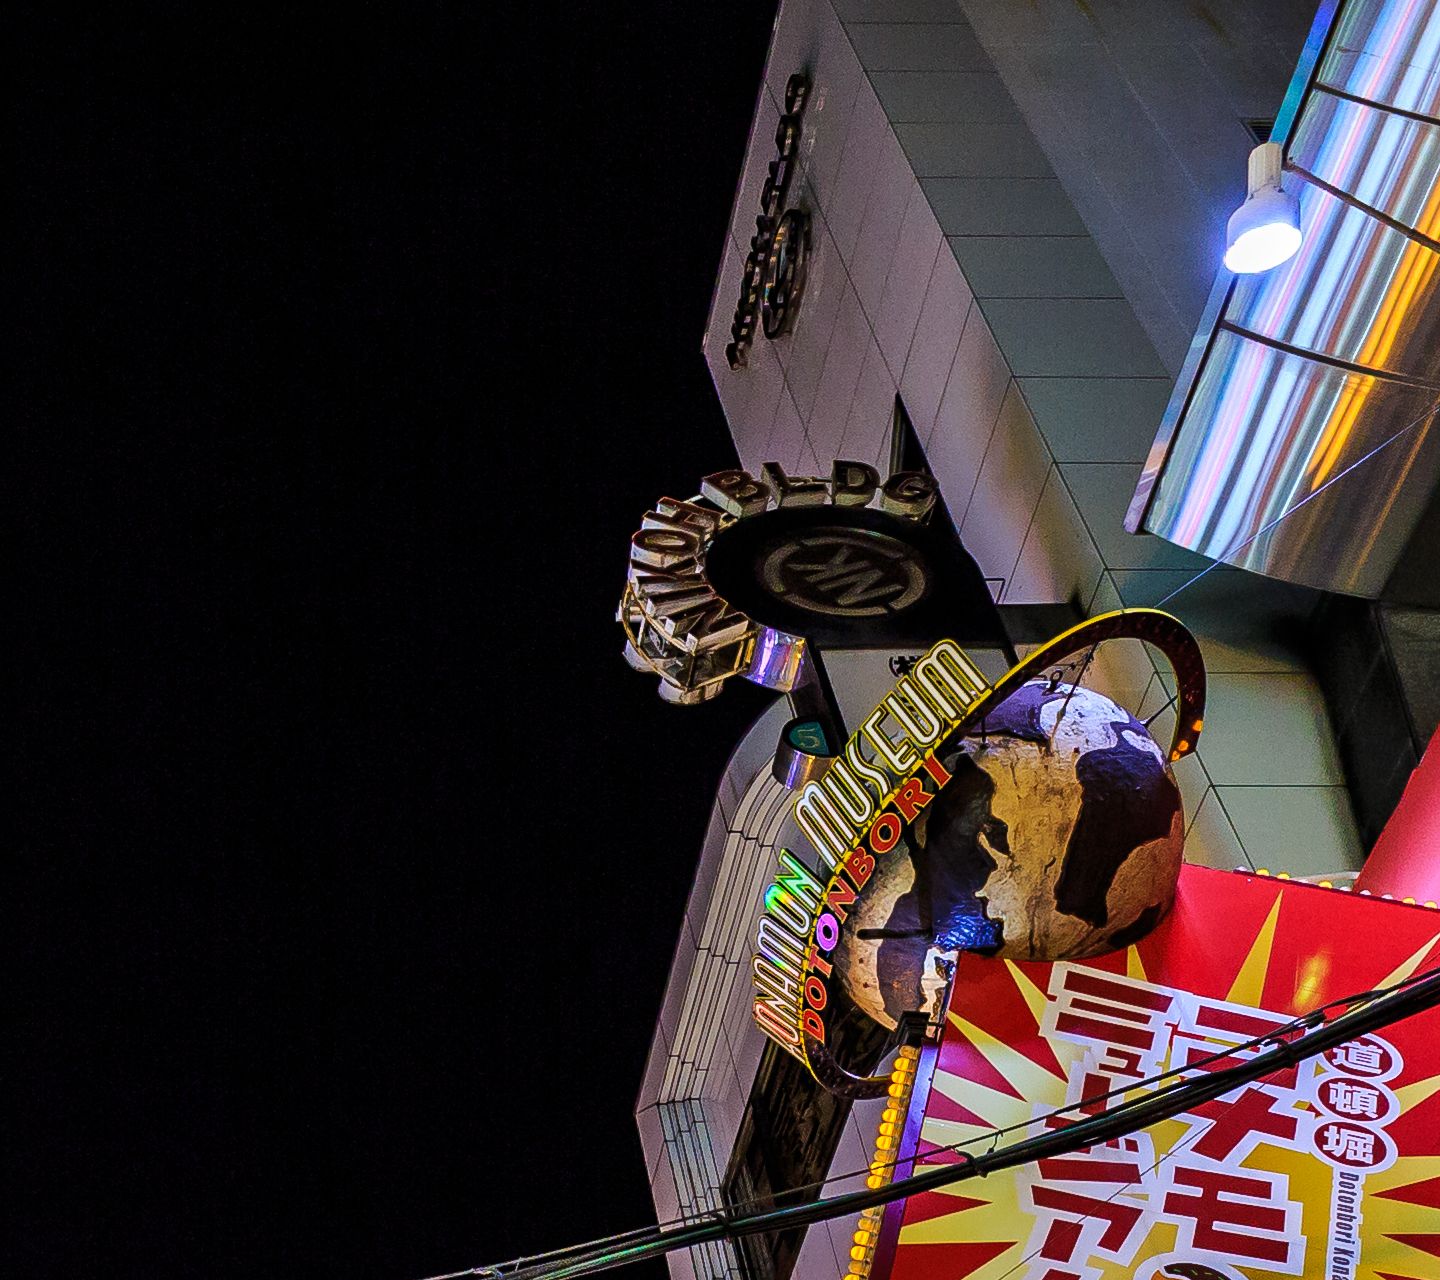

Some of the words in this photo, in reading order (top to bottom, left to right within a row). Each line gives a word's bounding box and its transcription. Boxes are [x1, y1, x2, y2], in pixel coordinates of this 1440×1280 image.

[701, 459, 938, 525] BLDG
[754, 848, 824, 1068] KONAMON
[794, 639, 991, 868] MUSEUM
[801, 750, 951, 1042] DOTONBORI
[1314, 1033, 1402, 1172] 道頓堀
[1335, 1173, 1359, 1238] Dotonbori
